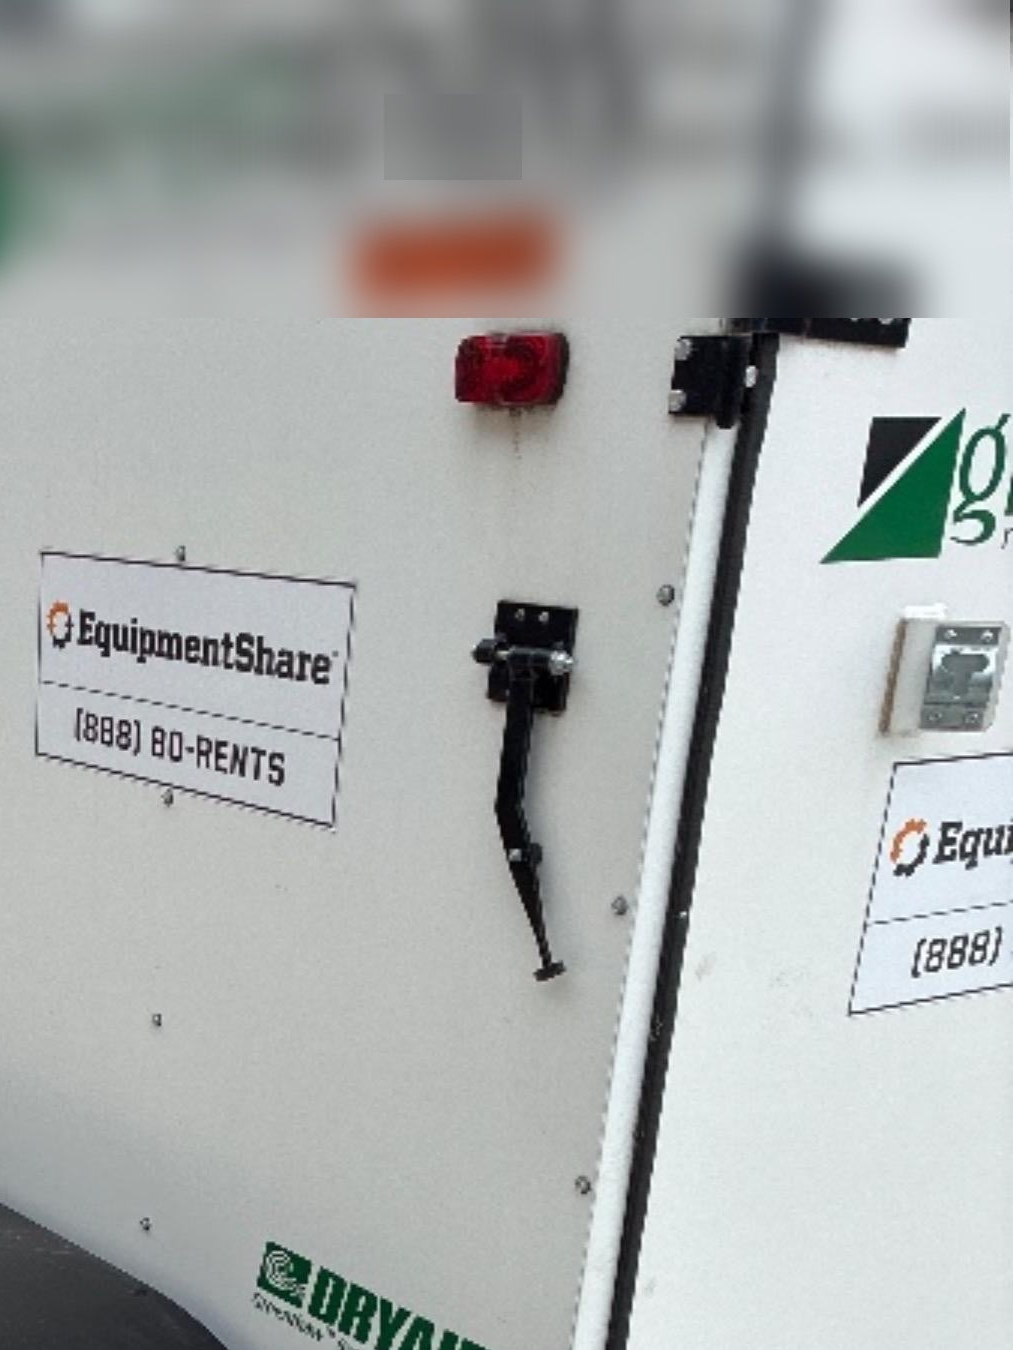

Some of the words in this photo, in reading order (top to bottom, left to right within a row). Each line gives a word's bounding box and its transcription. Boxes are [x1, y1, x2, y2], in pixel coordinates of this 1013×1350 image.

[950, 412, 1013, 546] g
[76, 608, 332, 685] EquipmentShare
[74, 707, 141, 757] (888)
[151, 725, 286, 787] 80-RENTS
[910, 926, 1003, 979] (888)
